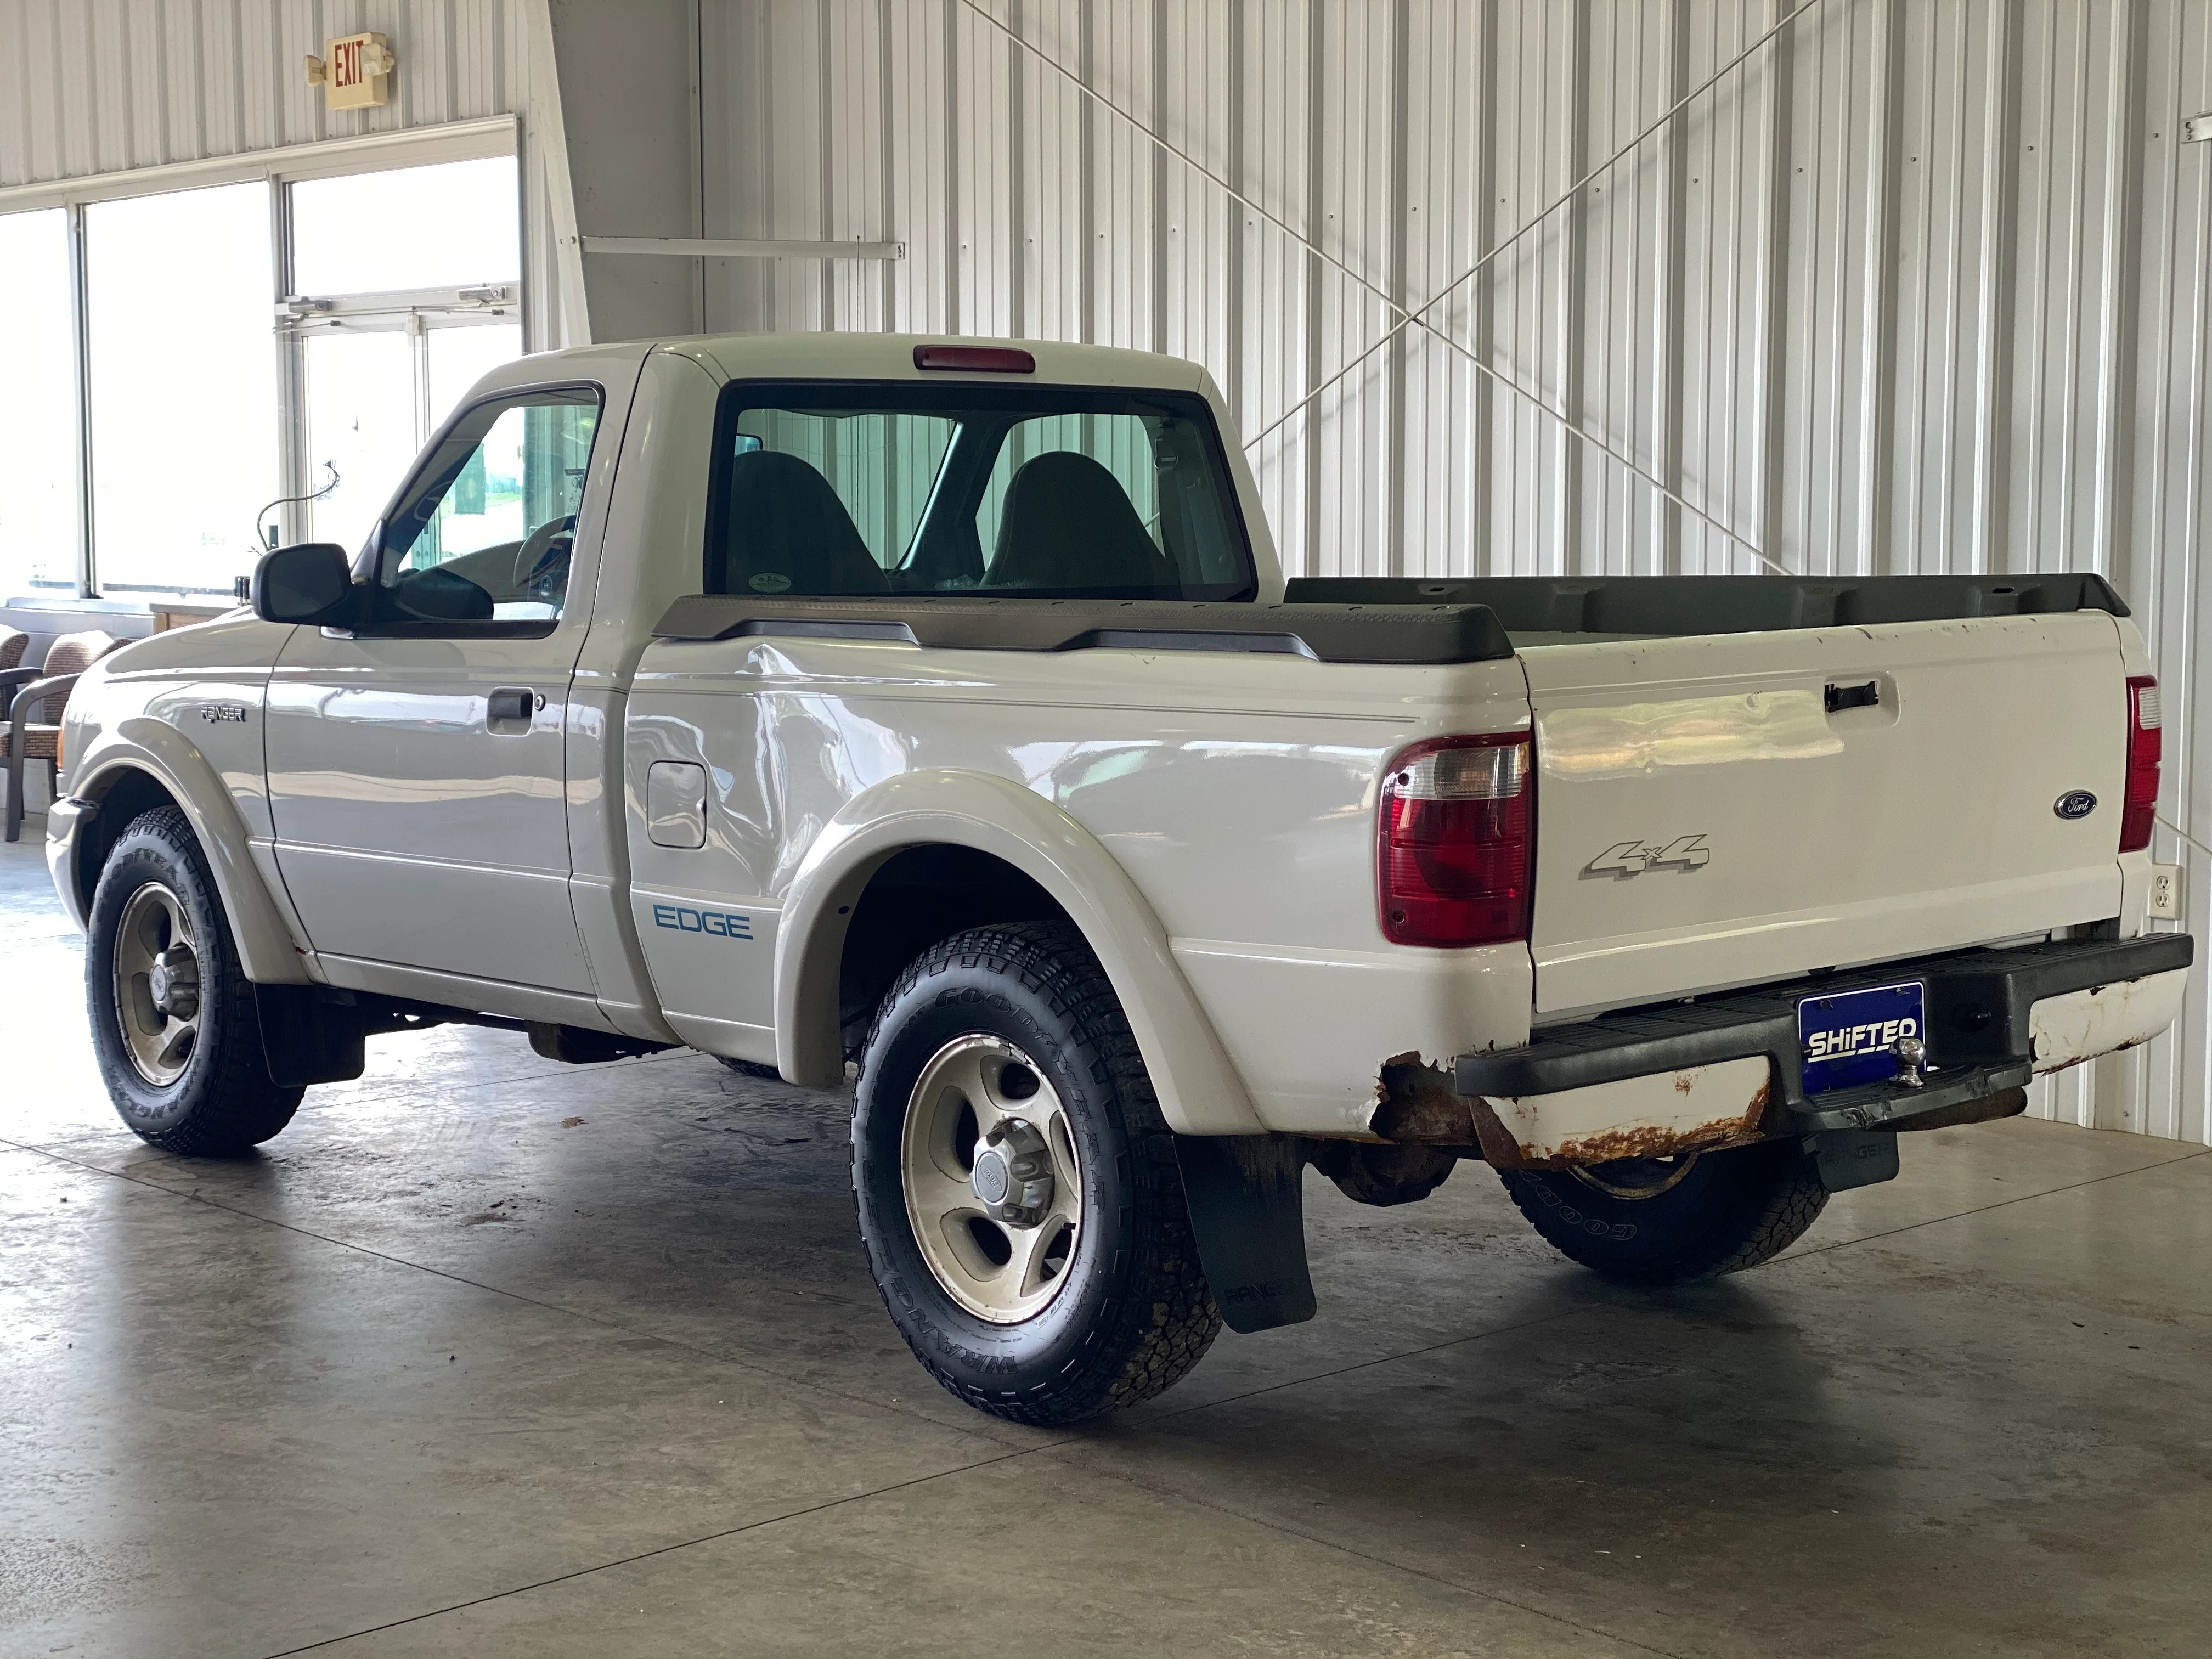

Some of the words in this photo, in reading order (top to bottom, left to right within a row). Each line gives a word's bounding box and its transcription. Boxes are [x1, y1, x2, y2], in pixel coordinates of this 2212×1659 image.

[334, 40, 363, 87] EXIT
[2068, 797, 2090, 812] Ford
[653, 904, 754, 940] EDGE
[934, 986, 1105, 1211] GOODYEAR
